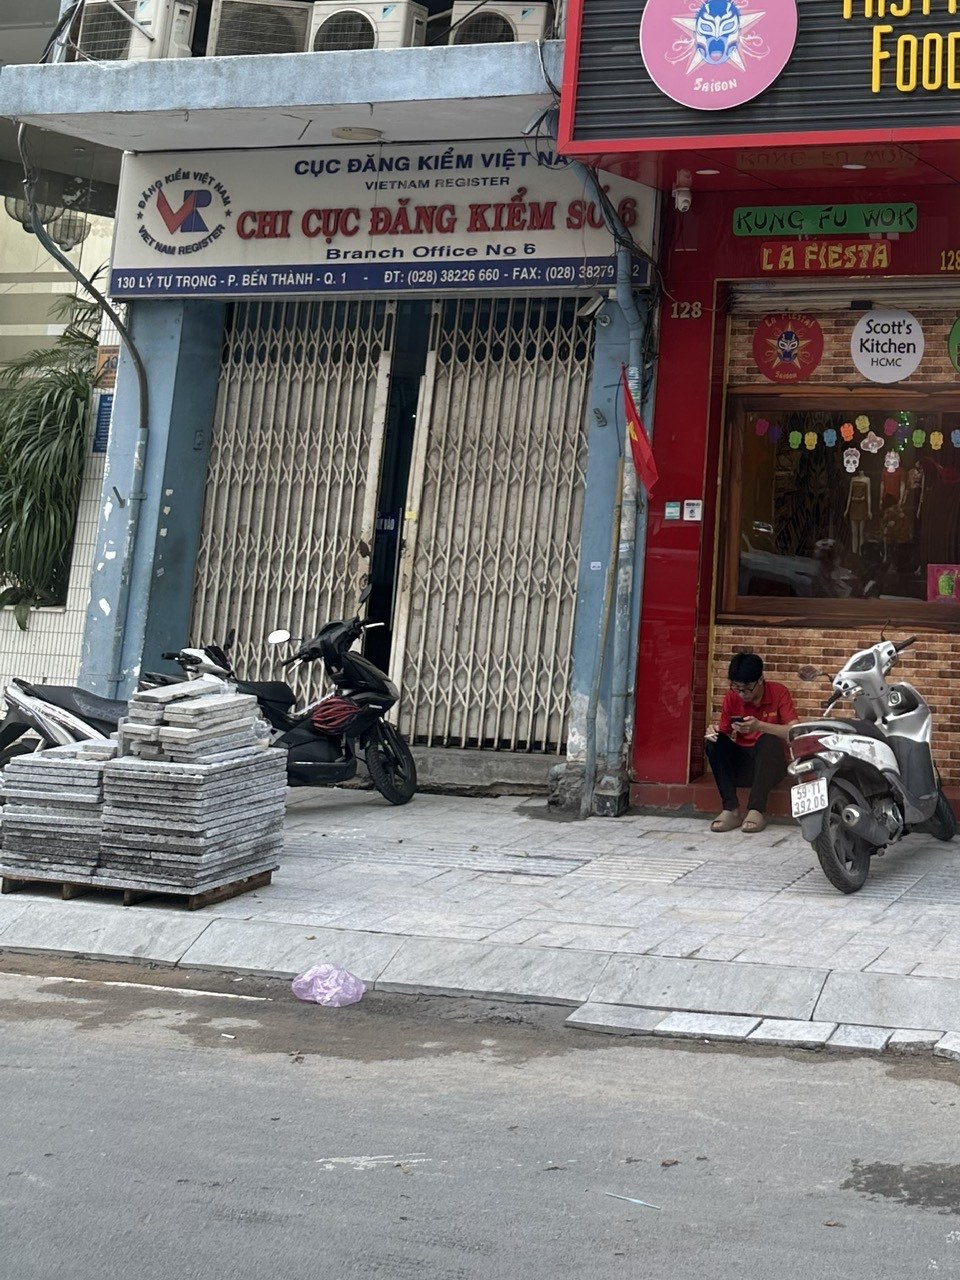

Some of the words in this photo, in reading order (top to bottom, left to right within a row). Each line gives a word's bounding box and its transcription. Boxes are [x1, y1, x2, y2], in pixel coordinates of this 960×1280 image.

[294, 159, 341, 177] CỤC
[347, 154, 411, 173] ĐĂNG
[418, 147, 473, 170] KIỂM
[481, 148, 532, 171] VIỆT
[214, 182, 231, 206] NAM
[364, 179, 430, 191] VIETNAM
[434, 176, 510, 188] REGISTER
[236, 210, 293, 240] CHI
[301, 207, 361, 244] CỤC
[368, 198, 457, 236] ĐĂNG
[466, 186, 557, 233] KIỂM
[617, 197, 639, 229] 6
[736, 209, 805, 234] KUNG
[818, 206, 848, 230] FU
[863, 206, 916, 230] WOK
[154, 241, 176, 255] NAM
[178, 224, 226, 255] REGISTER
[326, 246, 404, 260] Branch
[412, 244, 478, 258] Office
[762, 244, 795, 270] LA
[804, 242, 890, 269] FIESTA
[116, 275, 136, 289] 130
[137, 271, 156, 288] LÝ
[157, 273, 175, 290] TỰ
[176, 274, 218, 290] TRỌNG
[228, 274, 239, 287] P.
[242, 269, 268, 286] BẾN
[271, 270, 313, 286] THÀNH
[324, 273, 336, 285] Q.
[341, 272, 347, 284] 1
[384, 271, 404, 283] ĐT:
[407, 270, 437, 286] (028)
[440, 269, 476, 283] 38226
[478, 268, 500, 281] 660
[512, 267, 541, 280] FAX:
[546, 266, 575, 282] (028)
[670, 301, 702, 318] 128
[865, 318, 913, 335] Scott's
[859, 337, 917, 355] Kitchen
[870, 357, 902, 368] HCMC
